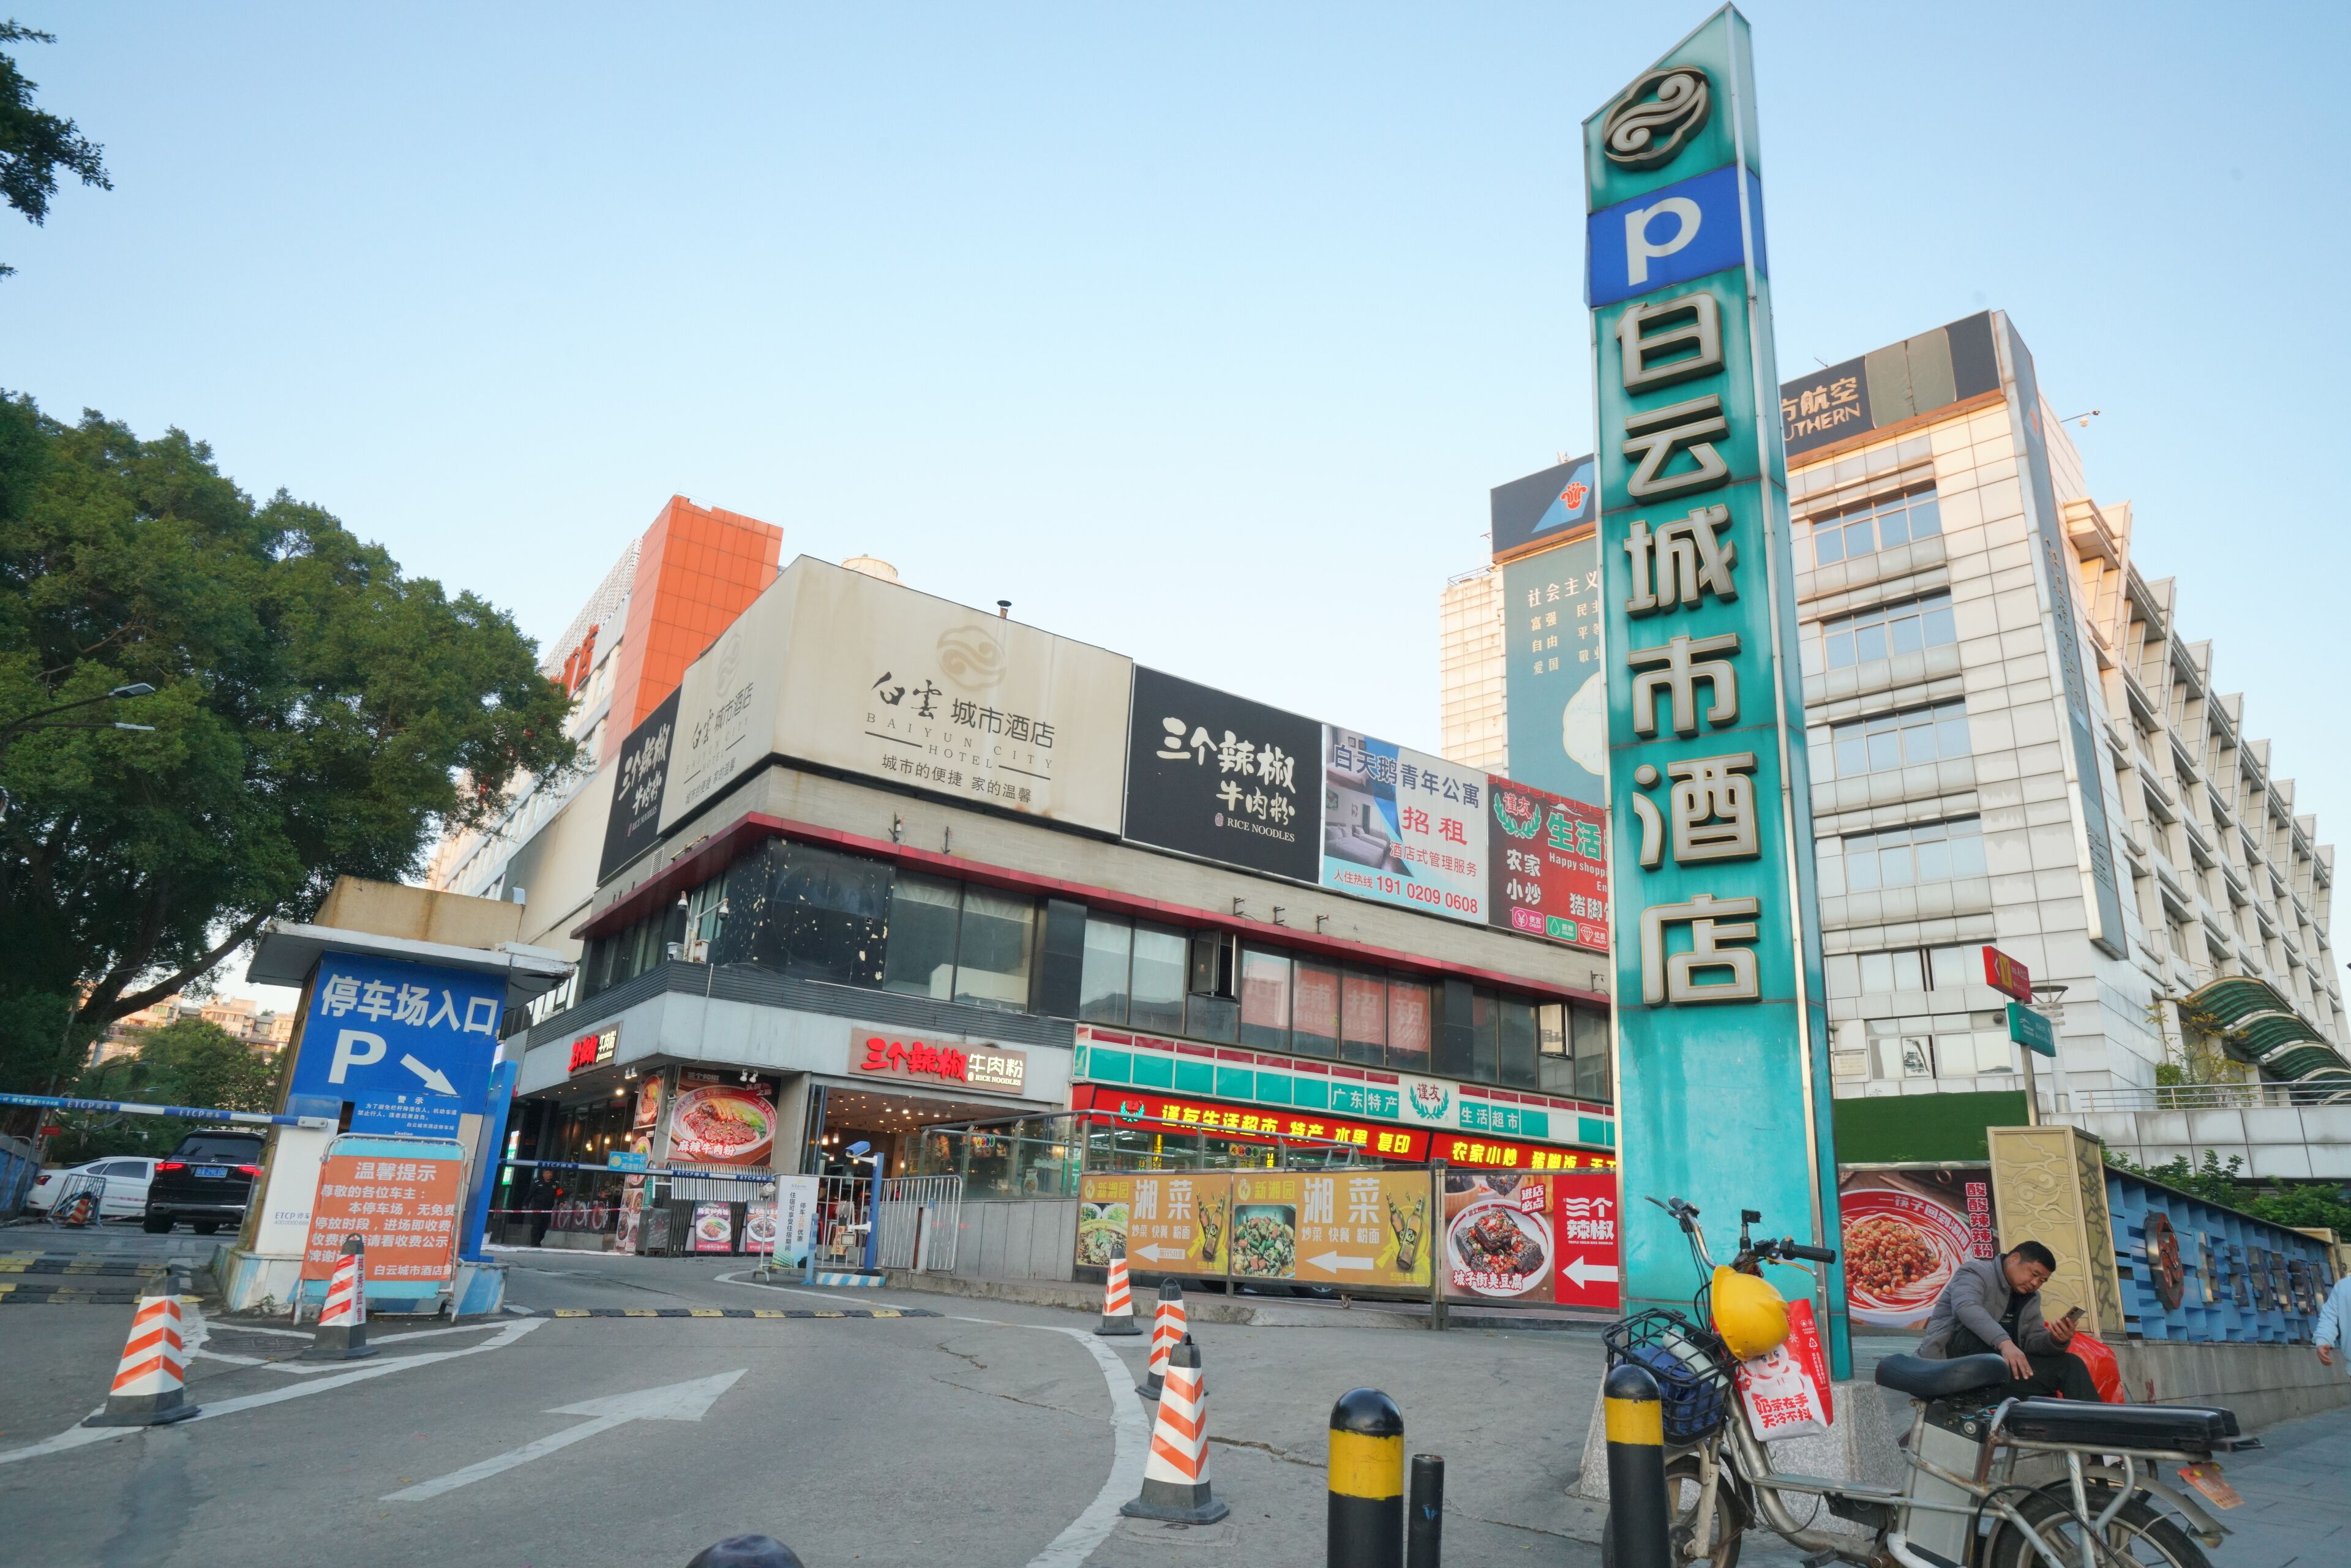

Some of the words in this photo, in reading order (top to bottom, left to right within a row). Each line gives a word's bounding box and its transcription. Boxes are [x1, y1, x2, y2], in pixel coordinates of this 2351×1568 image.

[1625, 197, 1702, 287] P
[1782, 377, 1859, 422] 方航空
[1528, 571, 1598, 607] 社会主义
[1531, 612, 1557, 631] 富强
[1532, 635, 1558, 653] 自由
[1615, 291, 1762, 1008] 白云城市酒店
[1534, 657, 1559, 675] 爱国
[866, 713, 972, 748] BAIYUN
[993, 746, 1053, 769] CITY
[928, 745, 993, 768] HOTEL
[1156, 717, 1296, 793] 三个辣椒
[882, 754, 963, 787] 城市的便捷
[971, 776, 1032, 803] 家的温馨
[1334, 745, 1479, 809] 白天鹅青年公寓
[1216, 780, 1295, 825] 牛肉粉
[1503, 792, 1532, 819] 谨友
[1227, 817, 1250, 831] RICE
[1251, 823, 1295, 842] NOODLES
[1401, 806, 1468, 846] 招租
[1547, 812, 1608, 862] 生活
[1390, 841, 1477, 877] 酒店式管理服务
[1507, 849, 1541, 877] 农家
[1549, 852, 1577, 871] Happy
[1333, 868, 1373, 889] 入住热线
[1376, 876, 1401, 895] 191
[1407, 883, 1441, 905] 0209
[1445, 892, 1479, 914] 0608
[1507, 879, 1542, 905] 小炒
[1594, 931, 1605, 940] 优质
[321, 973, 499, 1036] 停车场入口
[328, 1029, 387, 1084] P
[861, 1038, 967, 1082] 三个辣椒
[969, 1053, 1024, 1079] 牛肉粉
[975, 1074, 991, 1082] RICE
[991, 1076, 1021, 1086] NOODLES
[1417, 1082, 1441, 1103] 谨友
[1332, 1087, 1398, 1119] 广东特产
[1461, 1106, 1520, 1129] 生活超市
[677, 1139, 737, 1157] 麻辣牛肉粉
[1289, 1121, 1324, 1142] 特产
[1378, 1132, 1411, 1154] 复印
[1452, 1141, 1517, 1166] 农家小炒
[354, 1161, 437, 1182] 温馨提示
[1134, 1179, 1193, 1220] 湘菜
[1303, 1177, 1380, 1224] 湘菜
[1521, 1185, 1544, 1200] 进店
[1521, 1197, 1544, 1213] 必点
[1566, 1197, 1613, 1217] 三个
[1966, 1182, 1993, 1258] 酸酸辣辣粉
[1131, 1224, 1148, 1238] 炒菜
[1152, 1225, 1168, 1239] 快餐
[1172, 1226, 1191, 1240] 粉面
[1302, 1226, 1322, 1242] 炒菜
[1329, 1227, 1351, 1243] 快餐
[1357, 1228, 1380, 1244] 粉面
[1566, 1220, 1614, 1240] 辣椒
[1755, 1392, 1809, 1415] 奶茶在手
[1761, 1408, 1813, 1429] 天冷不抖
